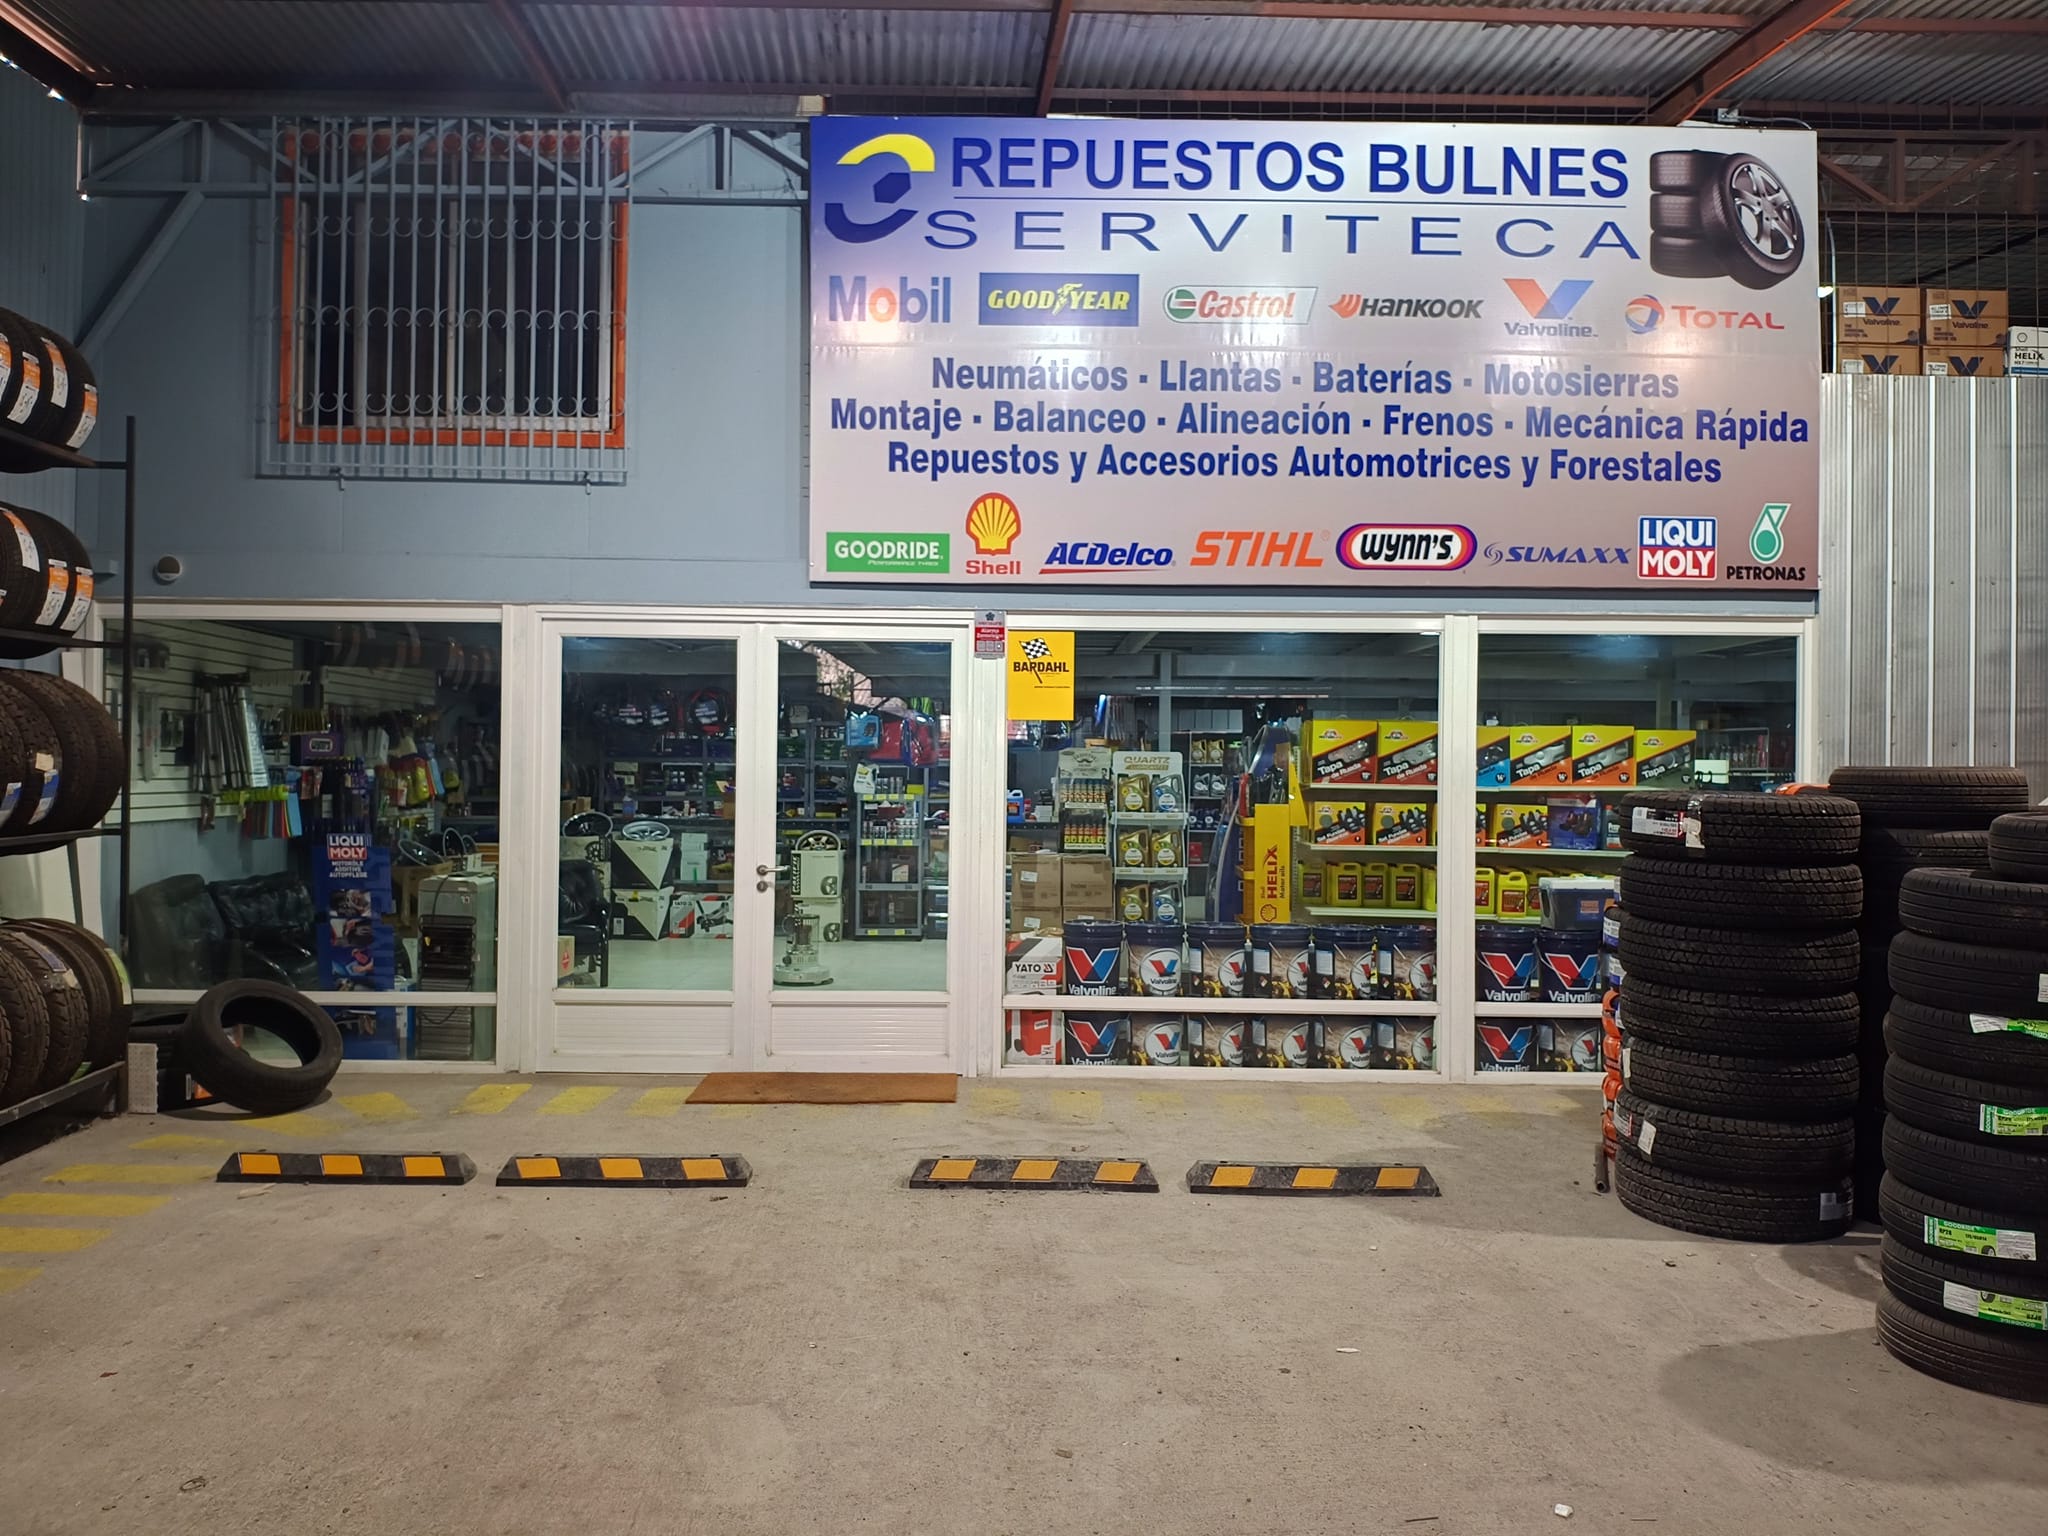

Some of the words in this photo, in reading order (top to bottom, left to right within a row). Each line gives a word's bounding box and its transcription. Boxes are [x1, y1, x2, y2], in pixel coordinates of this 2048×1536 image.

[952, 137, 1344, 193] REPUESTOS
[1369, 143, 1628, 199] BULNES
[924, 209, 1641, 260] SERVITECA
[829, 275, 951, 324] Mobil
[1197, 290, 1295, 319] Castrol
[1671, 305, 1785, 330] TOTAL
[1863, 318, 1900, 326] Valvoline
[1952, 320, 1989, 329] Valvoline
[1504, 322, 1593, 338] Valvoline
[2015, 351, 2045, 360] HELIX
[932, 357, 1128, 392] Neumáticos
[1161, 360, 1281, 393] Llantas
[1313, 361, 1452, 394] Baterías
[1484, 363, 1680, 399] Motosierras
[831, 398, 962, 440] Montaje
[993, 401, 1146, 434] Balanceo
[1177, 401, 1351, 435] Alineación
[1384, 404, 1494, 437] Frenos
[1525, 407, 1684, 441] Mecánica
[1696, 408, 1809, 449] Rápida
[888, 441, 1059, 482] Repuestos
[1070, 449, 1088, 483] y
[1097, 444, 1278, 477] Accesorios
[1289, 446, 1511, 480] Automotrices
[1522, 455, 1539, 488] y
[1551, 449, 1722, 483] Forestales
[1641, 519, 1714, 548] LIQUI
[834, 540, 940, 560] GOODRIDE
[1045, 543, 1173, 566] ACDelco
[1190, 531, 1325, 568] STIHL
[1505, 546, 1632, 565] SUMAXX
[965, 560, 1021, 576] Shell
[1641, 549, 1715, 578] MOLY
[1726, 566, 1806, 581] PETRONAS
[1013, 662, 1069, 673] BARDAHL
[1123, 756, 1170, 764] QUARTZ
[1317, 761, 1343, 775] Tapa
[1383, 762, 1409, 776] Tapa
[1516, 764, 1541, 778] Tapa
[1578, 763, 1603, 777] Tapa
[1641, 765, 1666, 779] Tapa
[329, 835, 364, 847] LIQUI
[330, 847, 365, 859] MOLY
[1266, 845, 1278, 899] HELIX
[1015, 964, 1041, 973] YATO
[1068, 984, 1117, 996] Valvoline
[1485, 988, 1531, 1002] Valvolin
